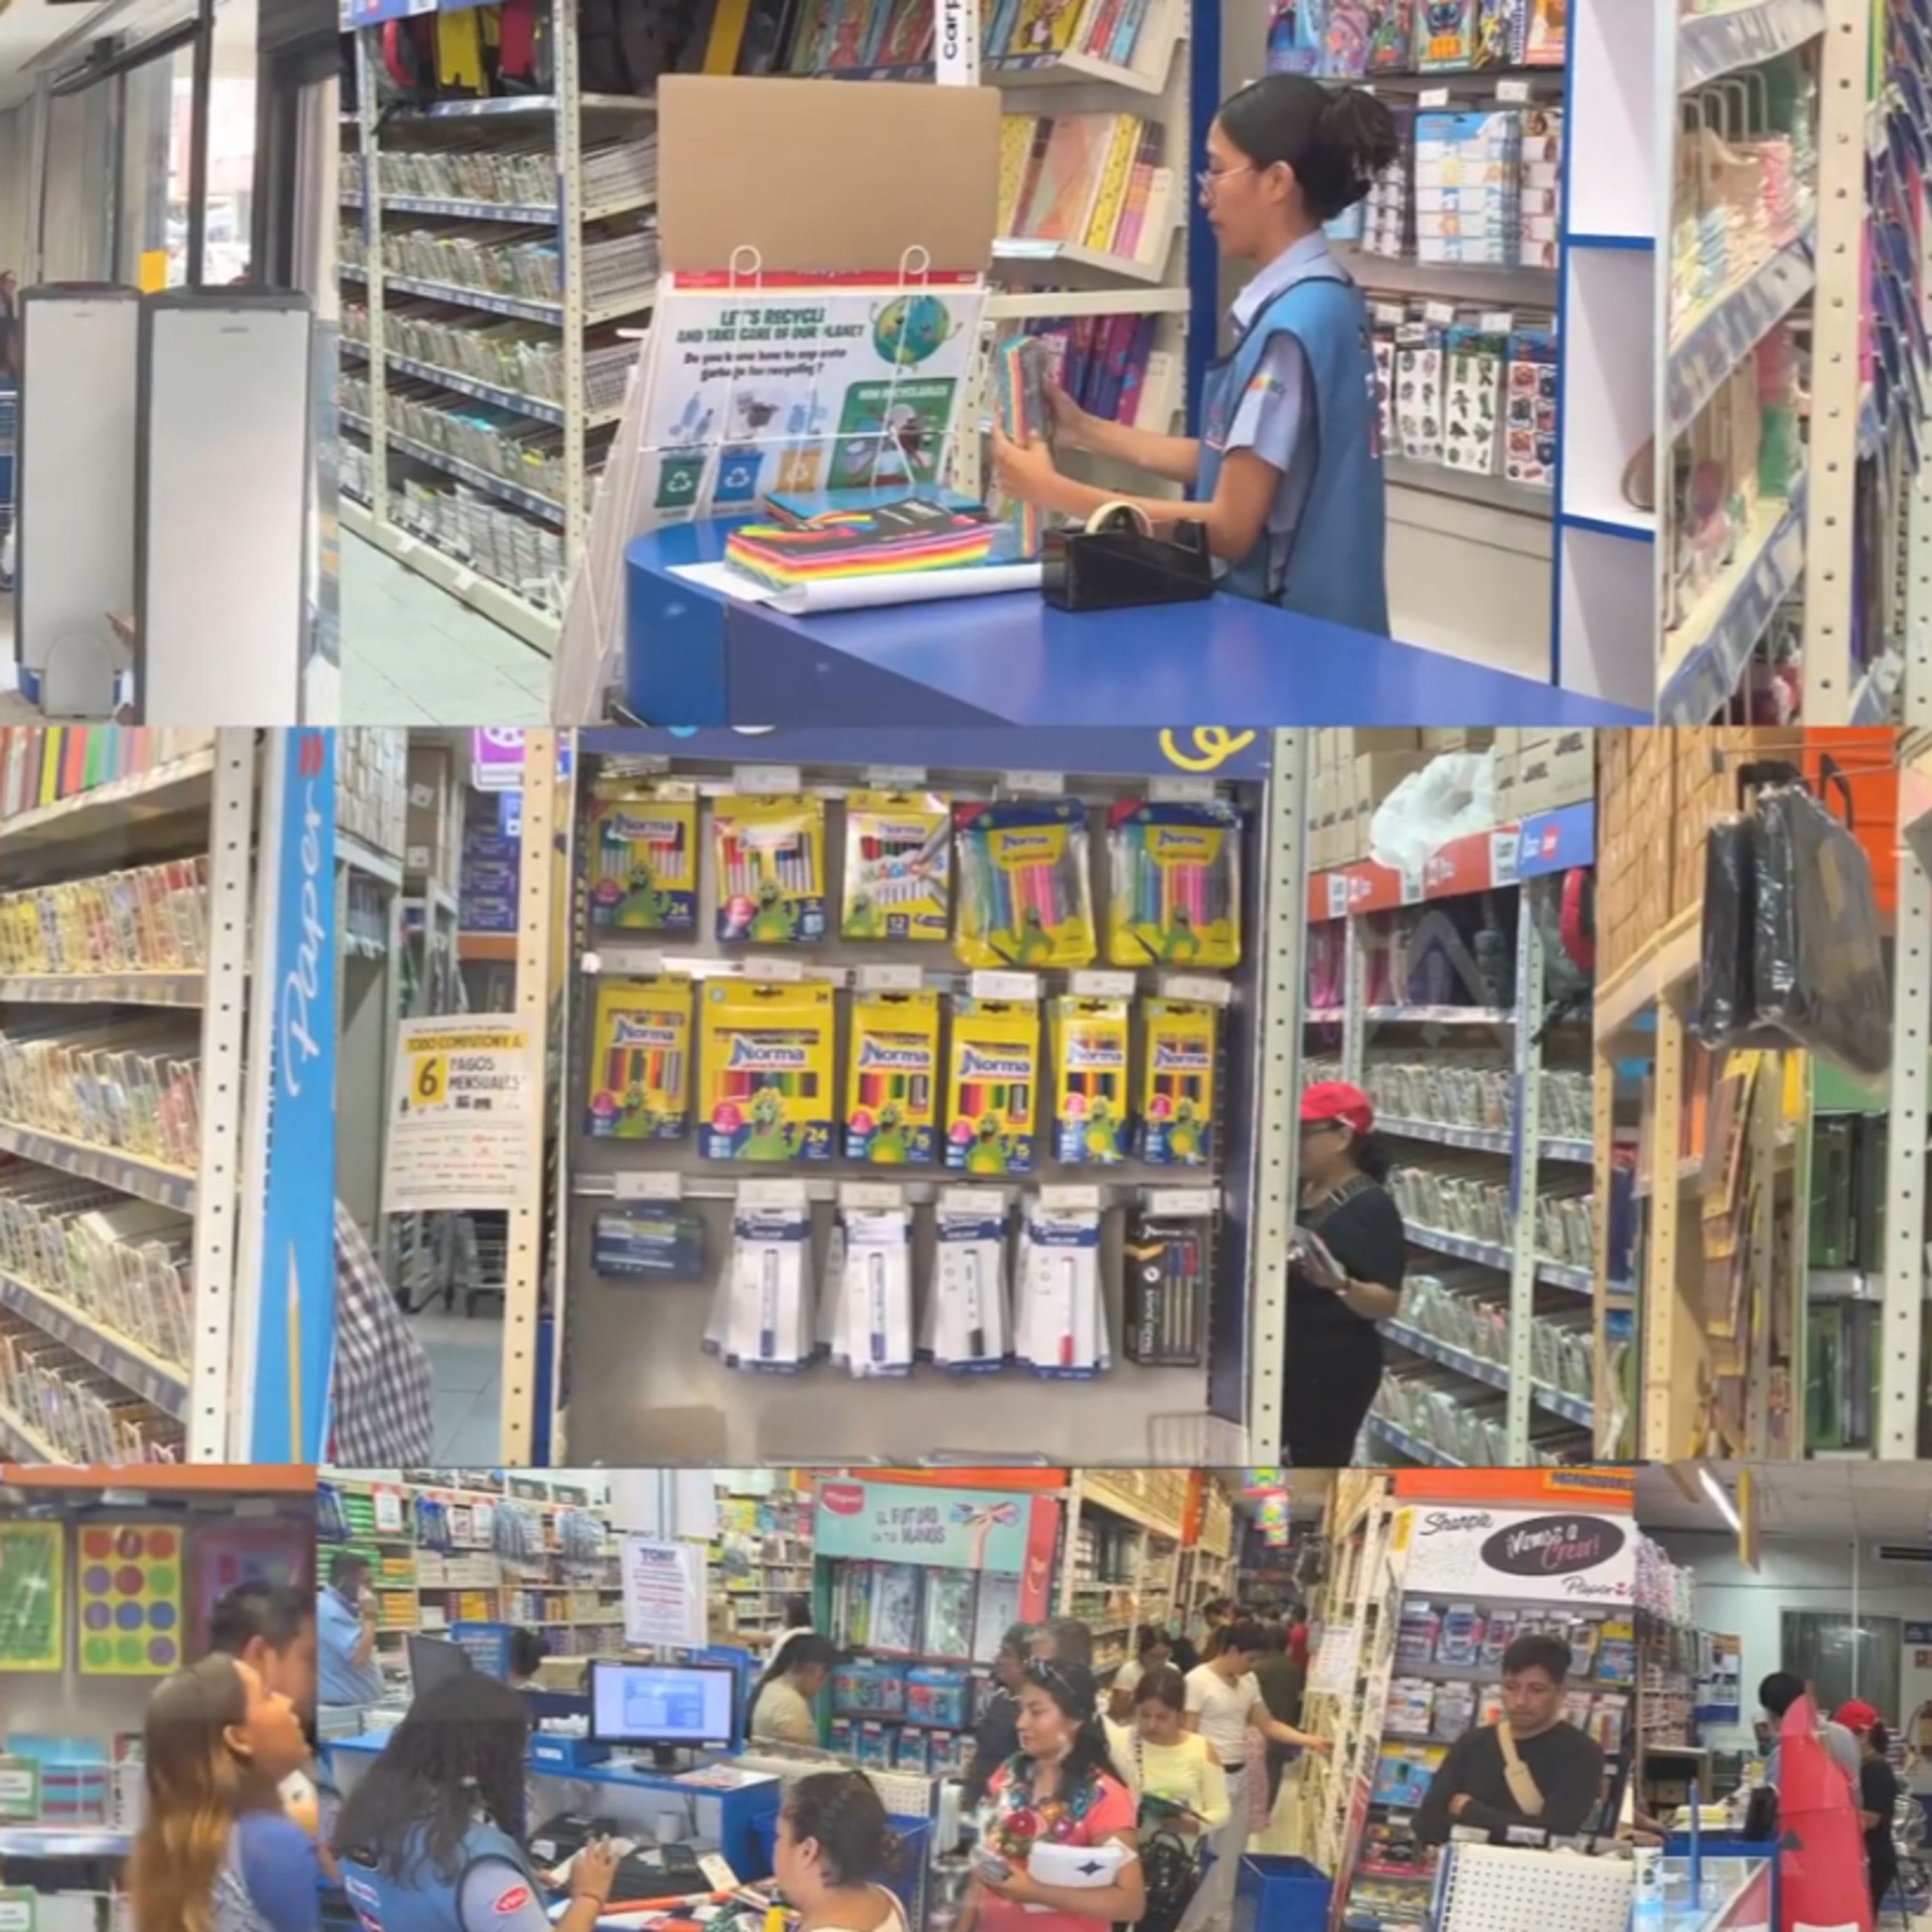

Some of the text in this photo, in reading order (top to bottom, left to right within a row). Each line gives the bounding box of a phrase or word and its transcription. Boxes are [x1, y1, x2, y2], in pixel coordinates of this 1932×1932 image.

[283, 781, 325, 1097] Paper
[614, 1016, 675, 1043] Norma
[450, 1057, 495, 1071] PAGOS
[728, 1036, 805, 1066] Norma
[858, 1039, 930, 1066] Norma
[959, 1048, 1030, 1075] Norma
[1153, 1046, 1208, 1068] Norma
[419, 1058, 439, 1097] 6
[808, 1127, 828, 1142] 24
[1419, 1511, 1494, 1536] Sharpie
